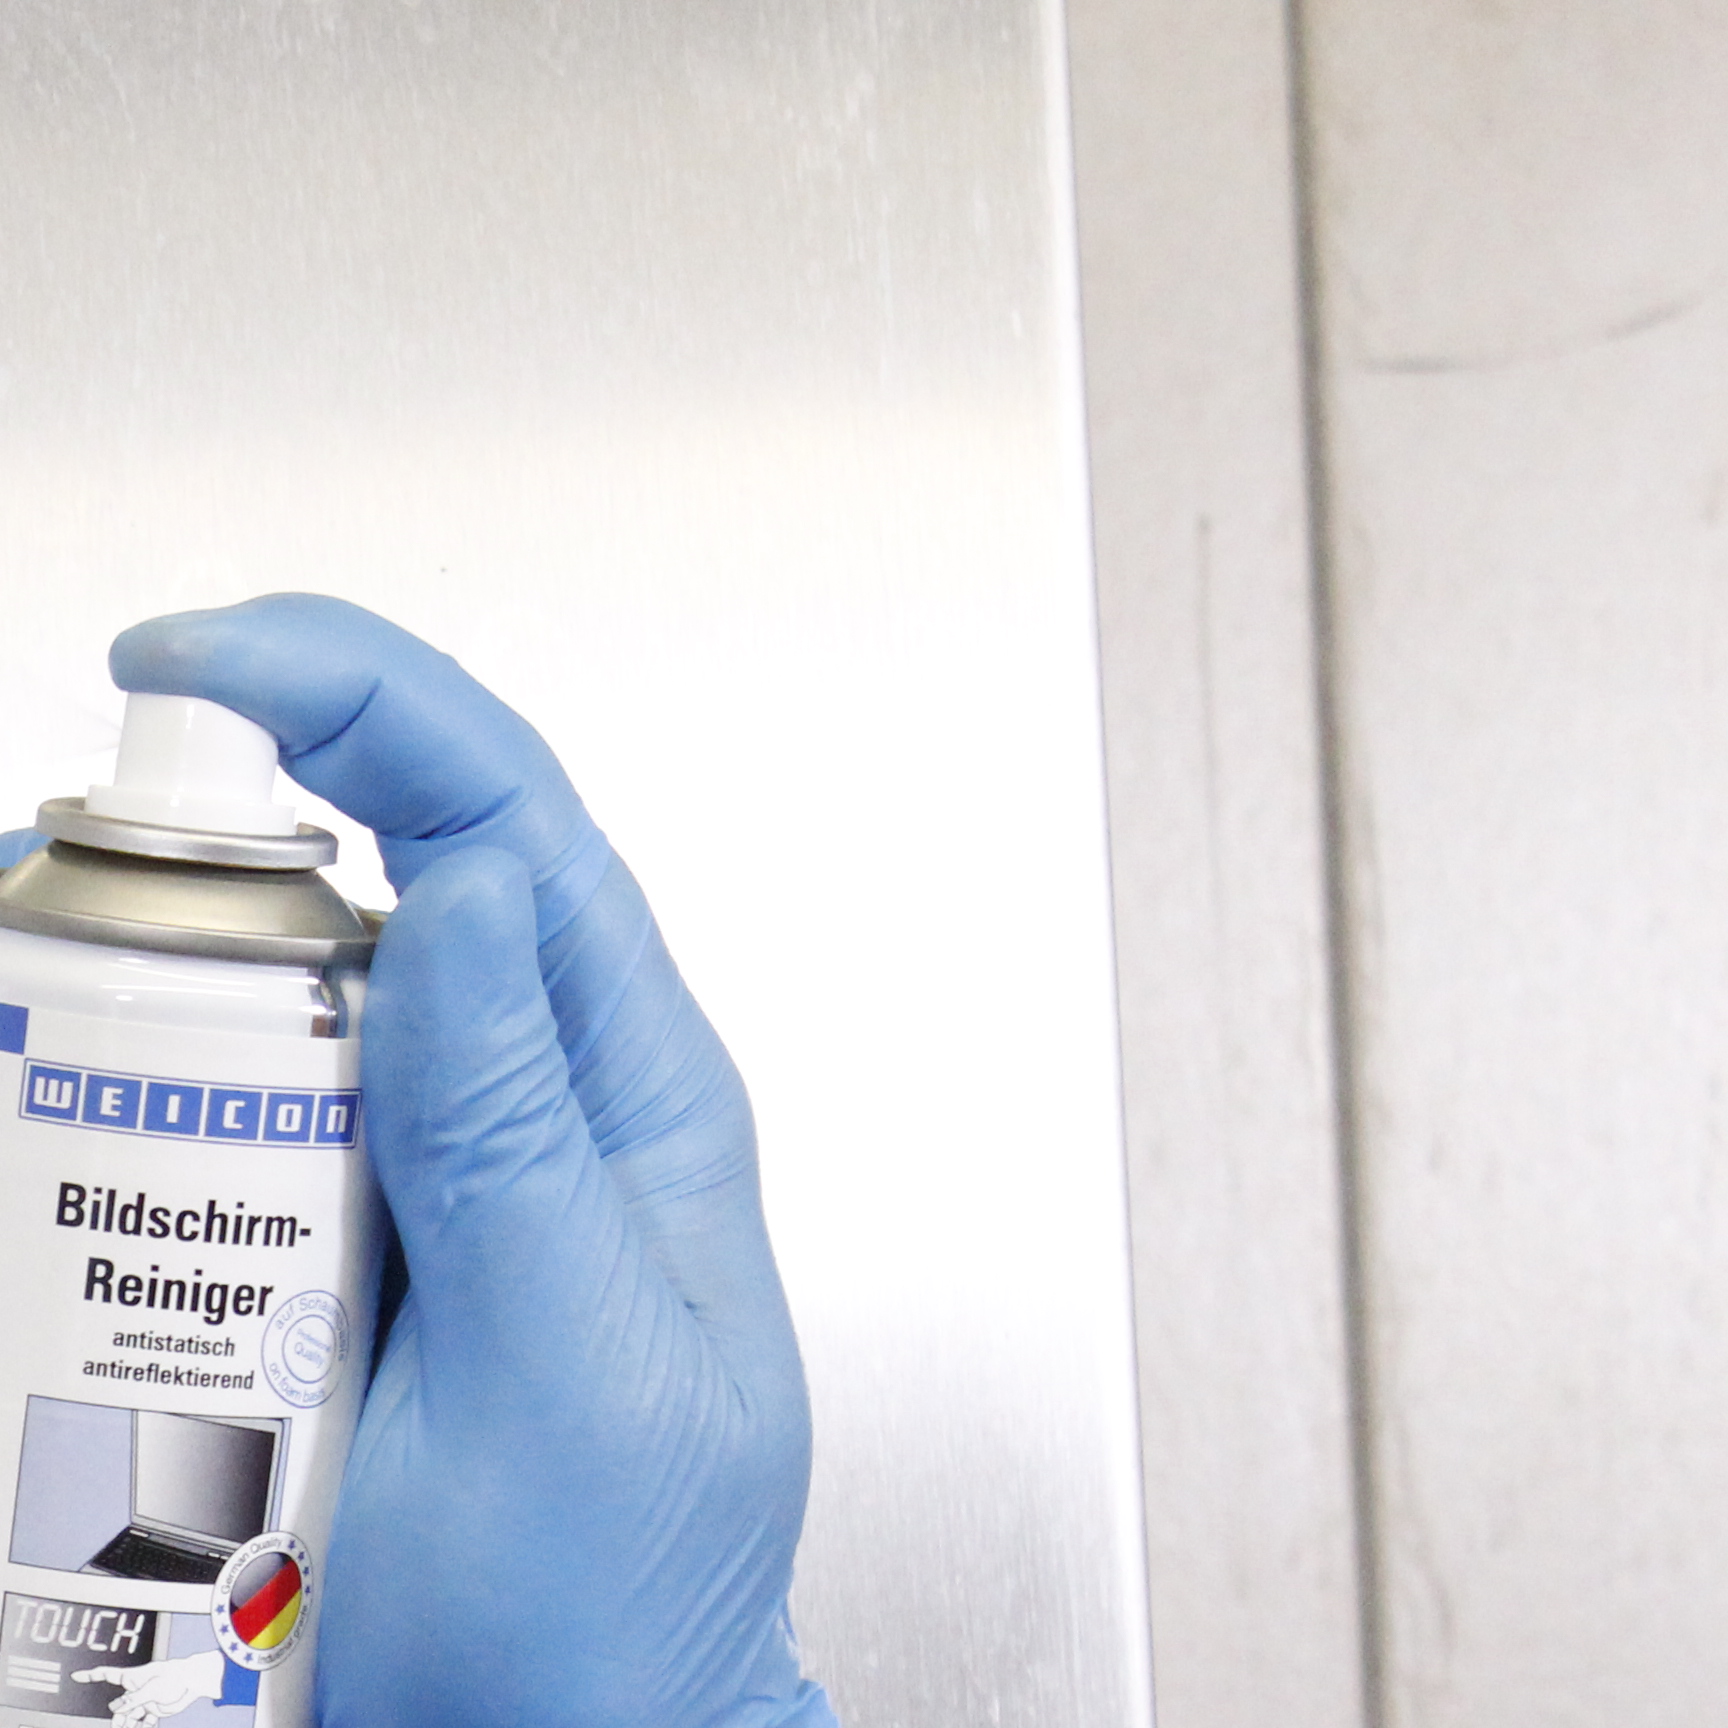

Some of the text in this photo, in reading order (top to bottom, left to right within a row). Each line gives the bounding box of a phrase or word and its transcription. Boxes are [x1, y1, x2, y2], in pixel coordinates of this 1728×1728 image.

[30, 1073, 351, 1138] WEICON
[55, 1181, 312, 1248] Bildschirm-
[83, 1256, 274, 1326] Reiniger
[112, 1330, 236, 1358] antistatisch
[82, 1359, 256, 1390] antireflektierend
[14, 1599, 146, 1655] TOUCH
